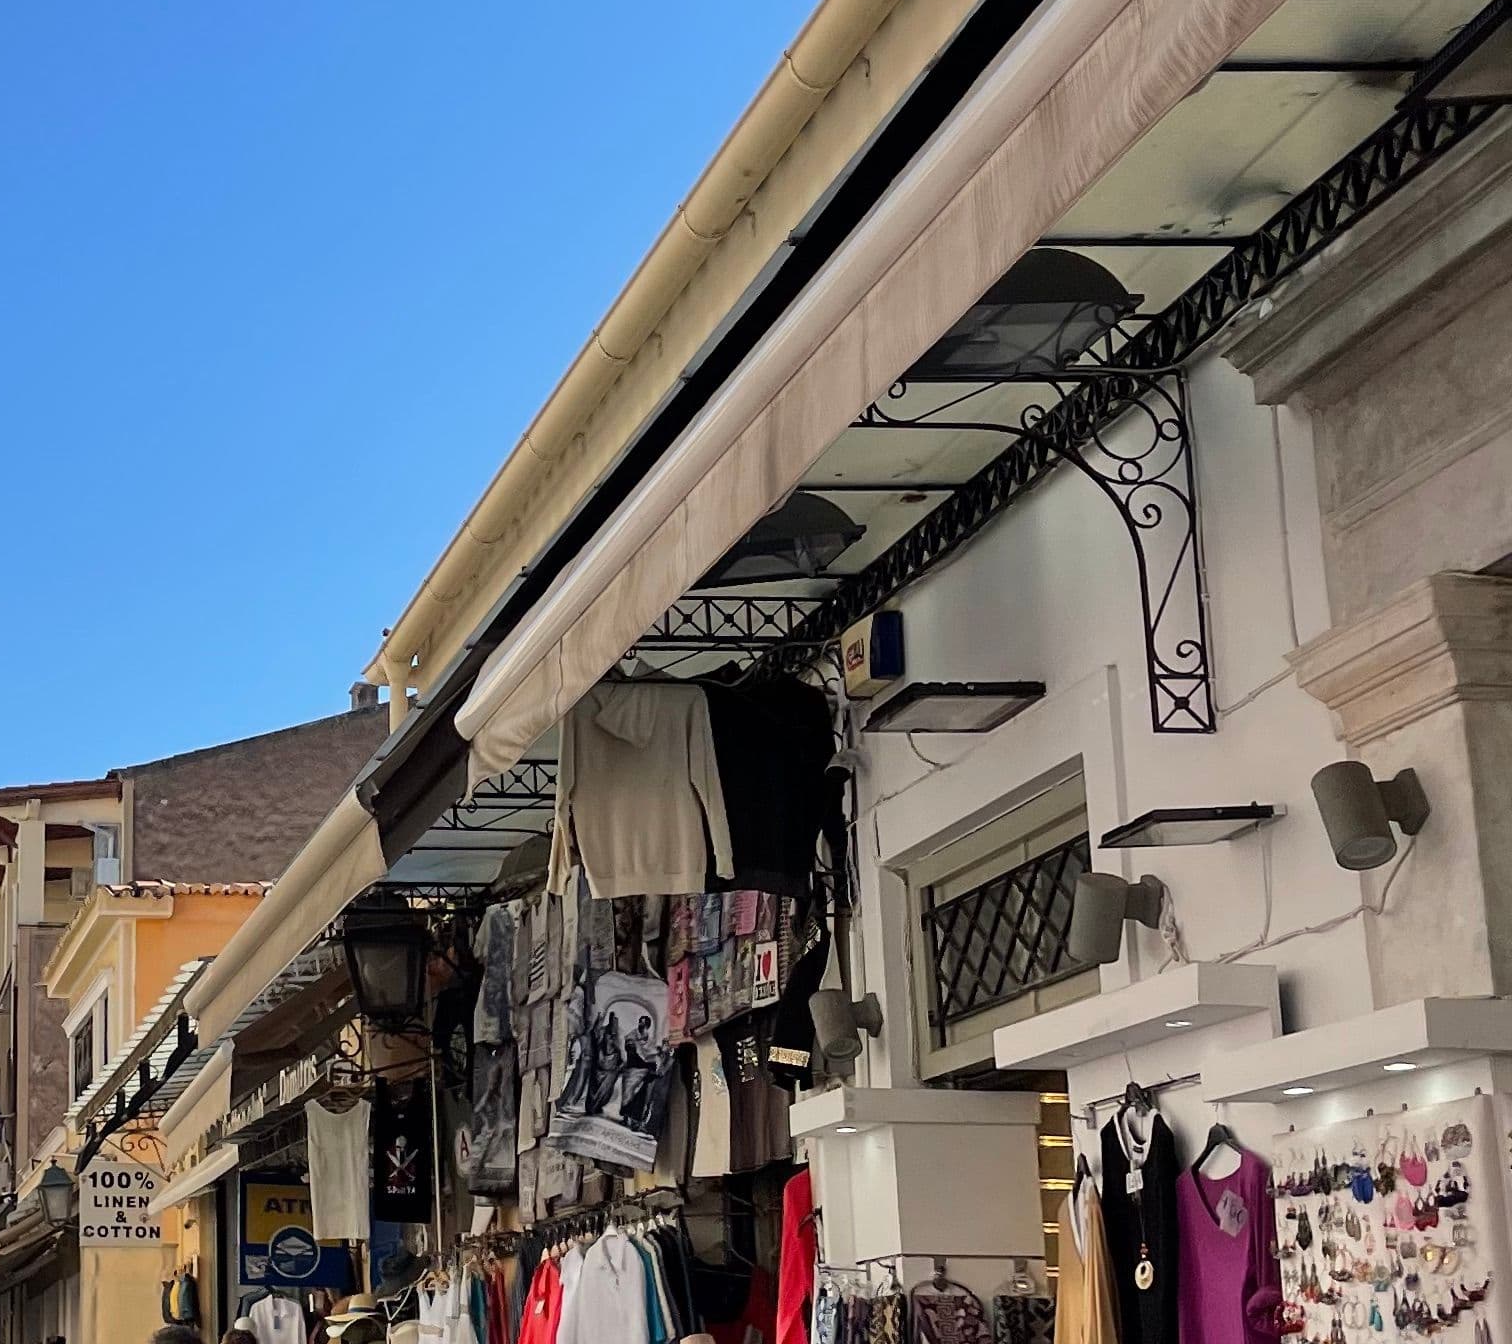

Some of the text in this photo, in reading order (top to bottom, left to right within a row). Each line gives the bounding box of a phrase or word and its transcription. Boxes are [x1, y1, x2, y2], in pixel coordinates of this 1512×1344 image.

[89, 1171, 154, 1189] 100%
[94, 1196, 149, 1208] LINEN
[116, 1211, 127, 1223] &
[84, 1225, 161, 1238] COTTON
